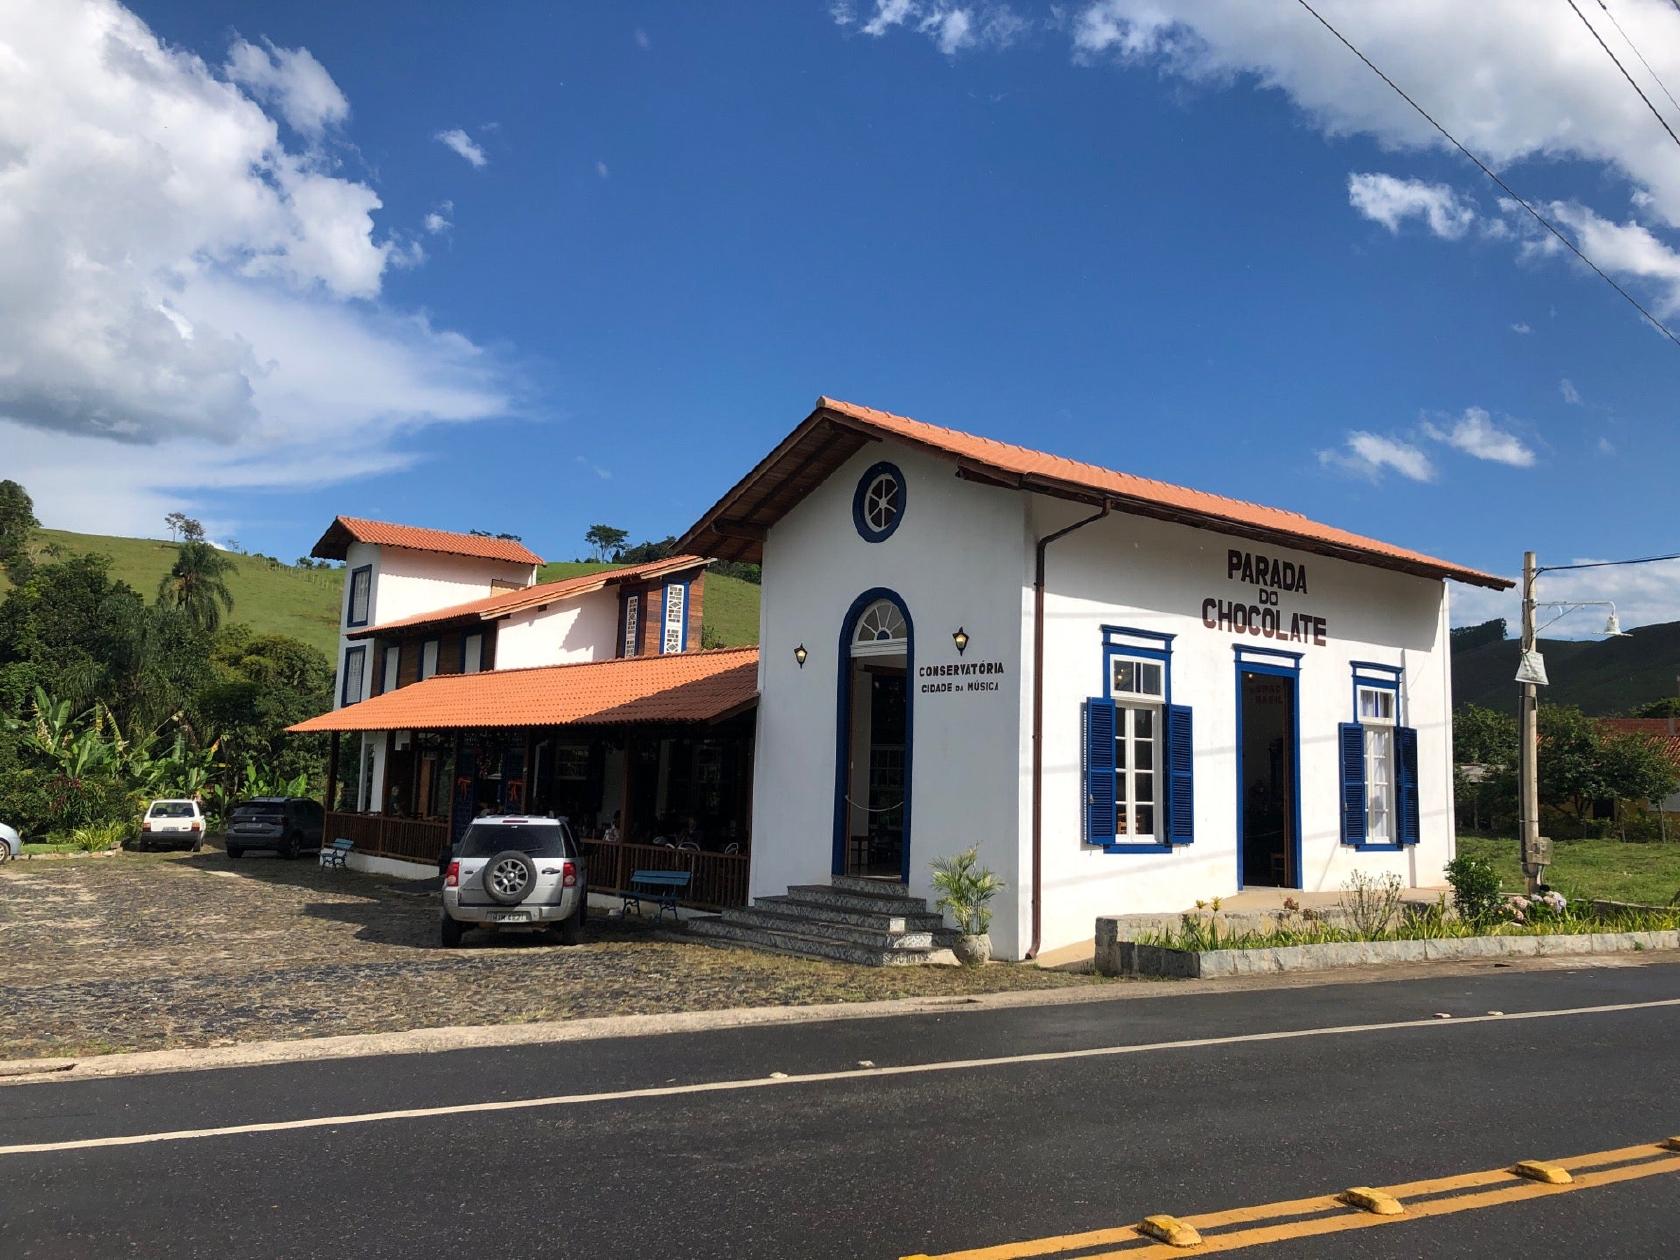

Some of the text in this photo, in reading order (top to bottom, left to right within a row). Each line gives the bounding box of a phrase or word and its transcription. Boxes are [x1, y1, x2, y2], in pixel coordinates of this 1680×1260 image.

[1227, 549, 1308, 594] PARADA
[1259, 588, 1279, 606] DO
[1202, 598, 1327, 647] CHOCOLATE
[921, 683, 953, 693] CIDADE
[967, 680, 999, 692] MÚSICA
